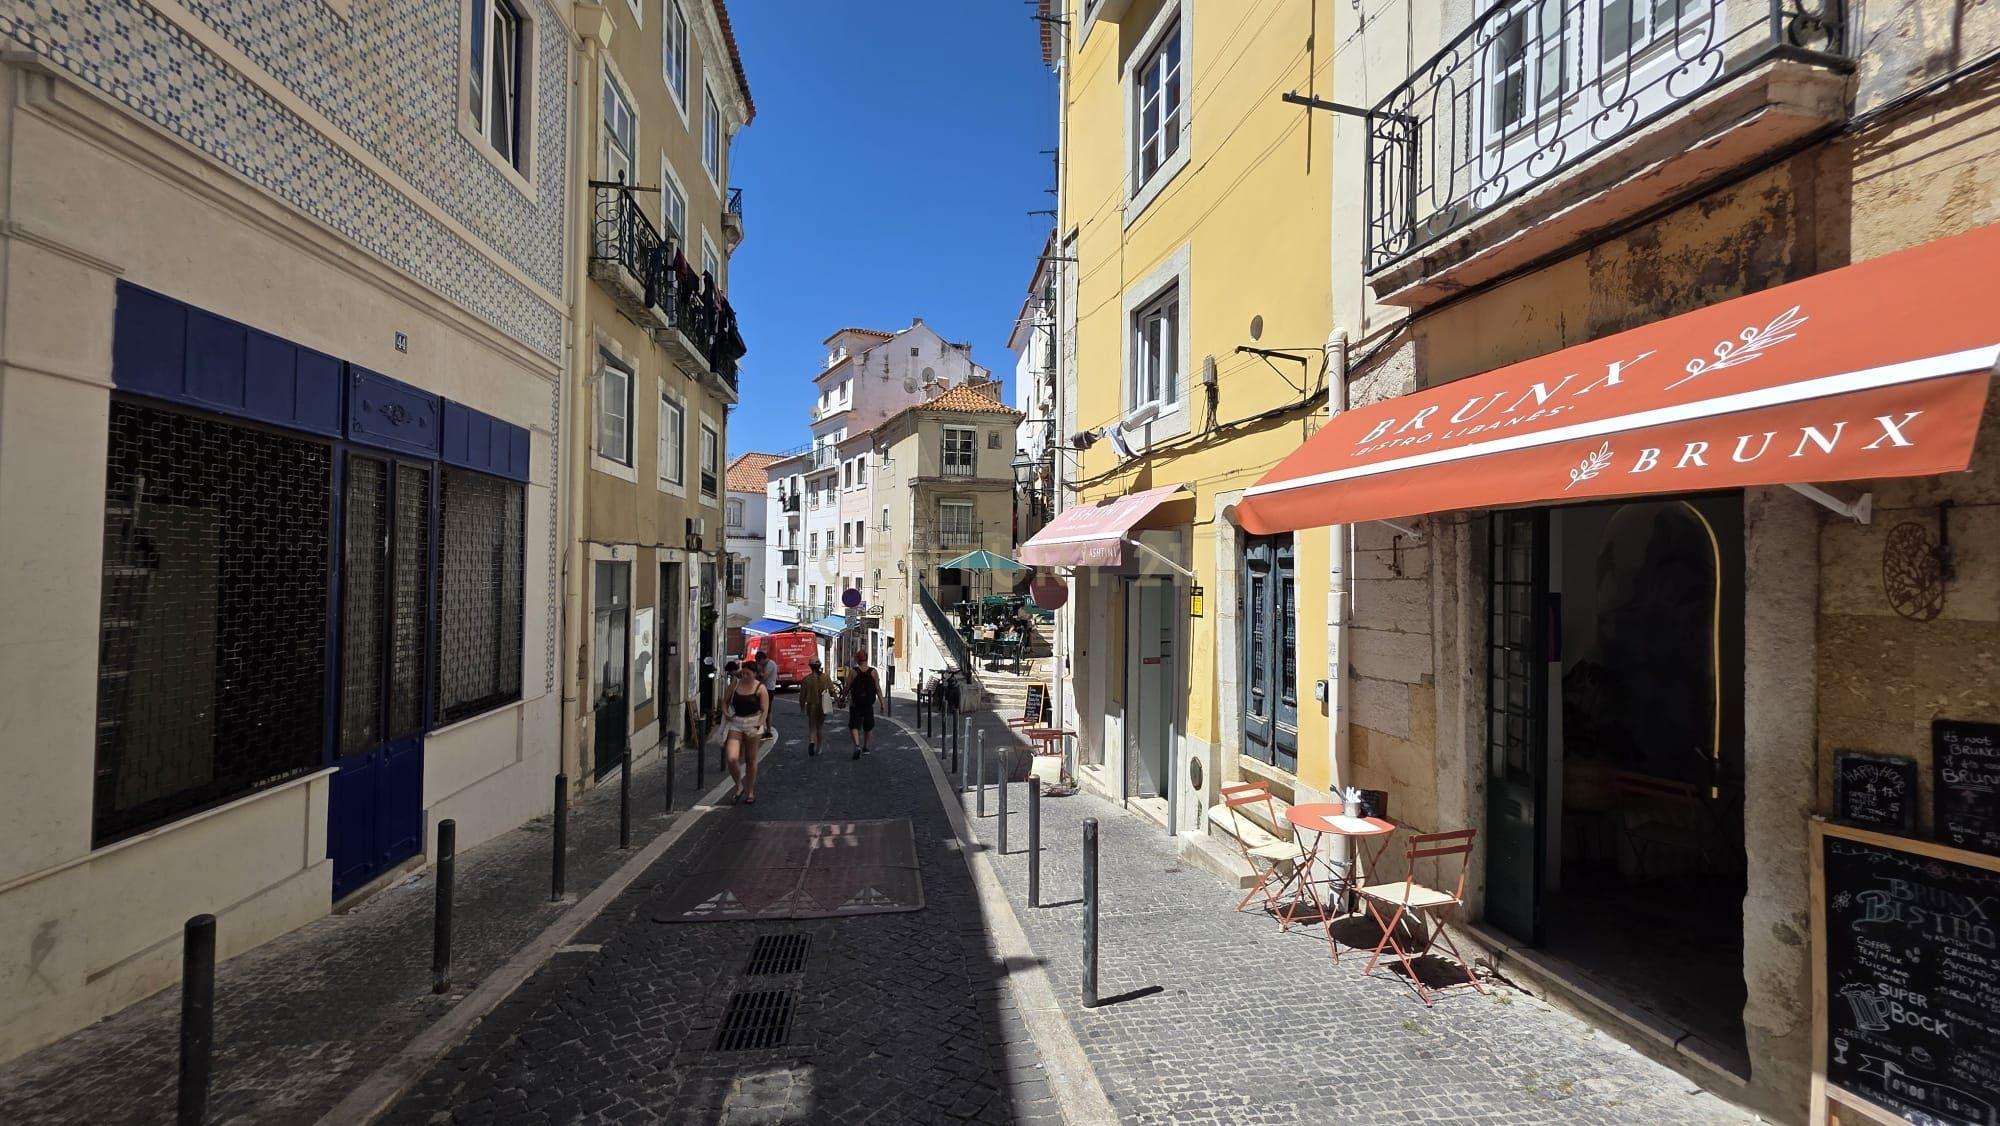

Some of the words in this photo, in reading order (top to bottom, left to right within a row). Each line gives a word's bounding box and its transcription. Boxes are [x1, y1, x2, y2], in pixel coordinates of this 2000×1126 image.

[397, 335, 406, 350] 44
[1357, 349, 1658, 445] BRUNX
[1628, 410, 1924, 476] BRUNX
[1950, 745, 2000, 758] BRUNC
[1942, 958, 1998, 982] AVOCADO
[1943, 969, 1976, 988] SPICY
[1878, 982, 1928, 1008] SUPER
[1890, 1000, 1950, 1039] BOCK
